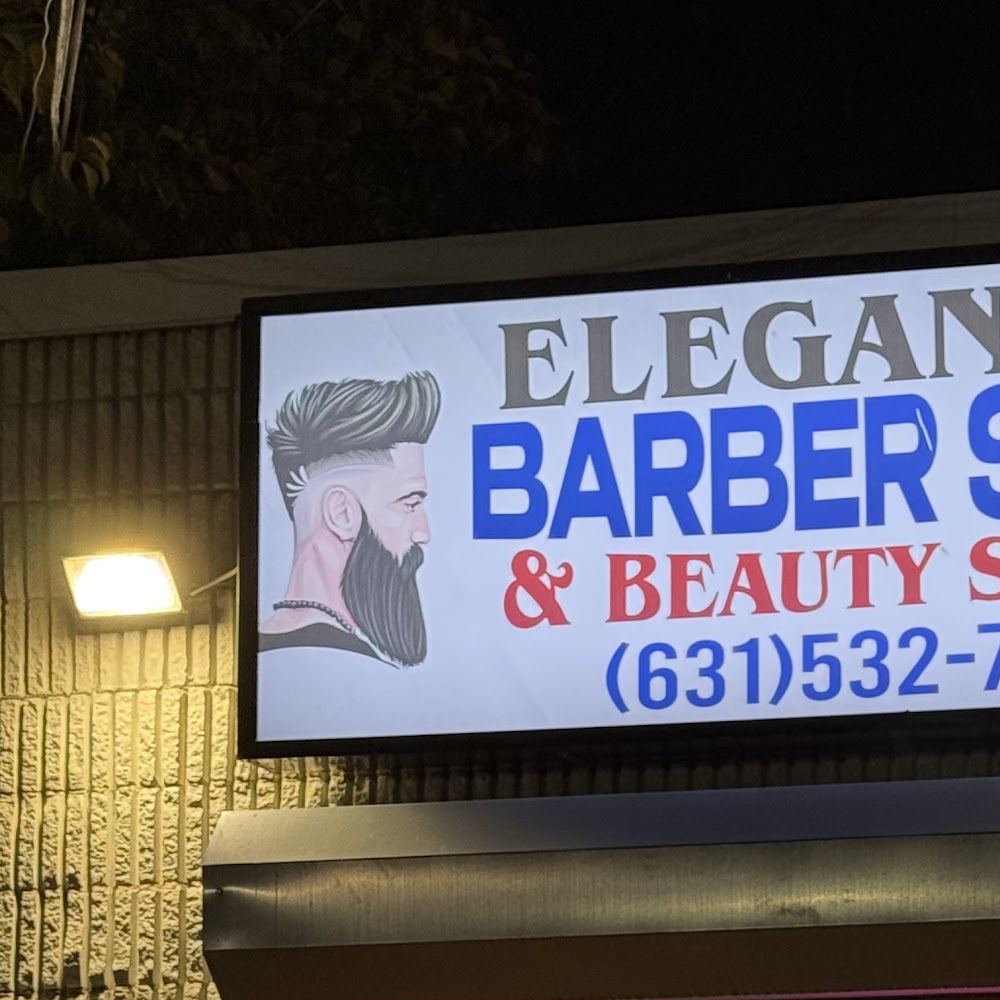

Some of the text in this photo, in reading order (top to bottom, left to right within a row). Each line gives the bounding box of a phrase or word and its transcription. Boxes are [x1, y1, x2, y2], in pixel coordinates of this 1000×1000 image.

[471, 393, 938, 540] BARBER
[503, 549, 574, 629] &
[605, 543, 942, 623] BEAUTY
